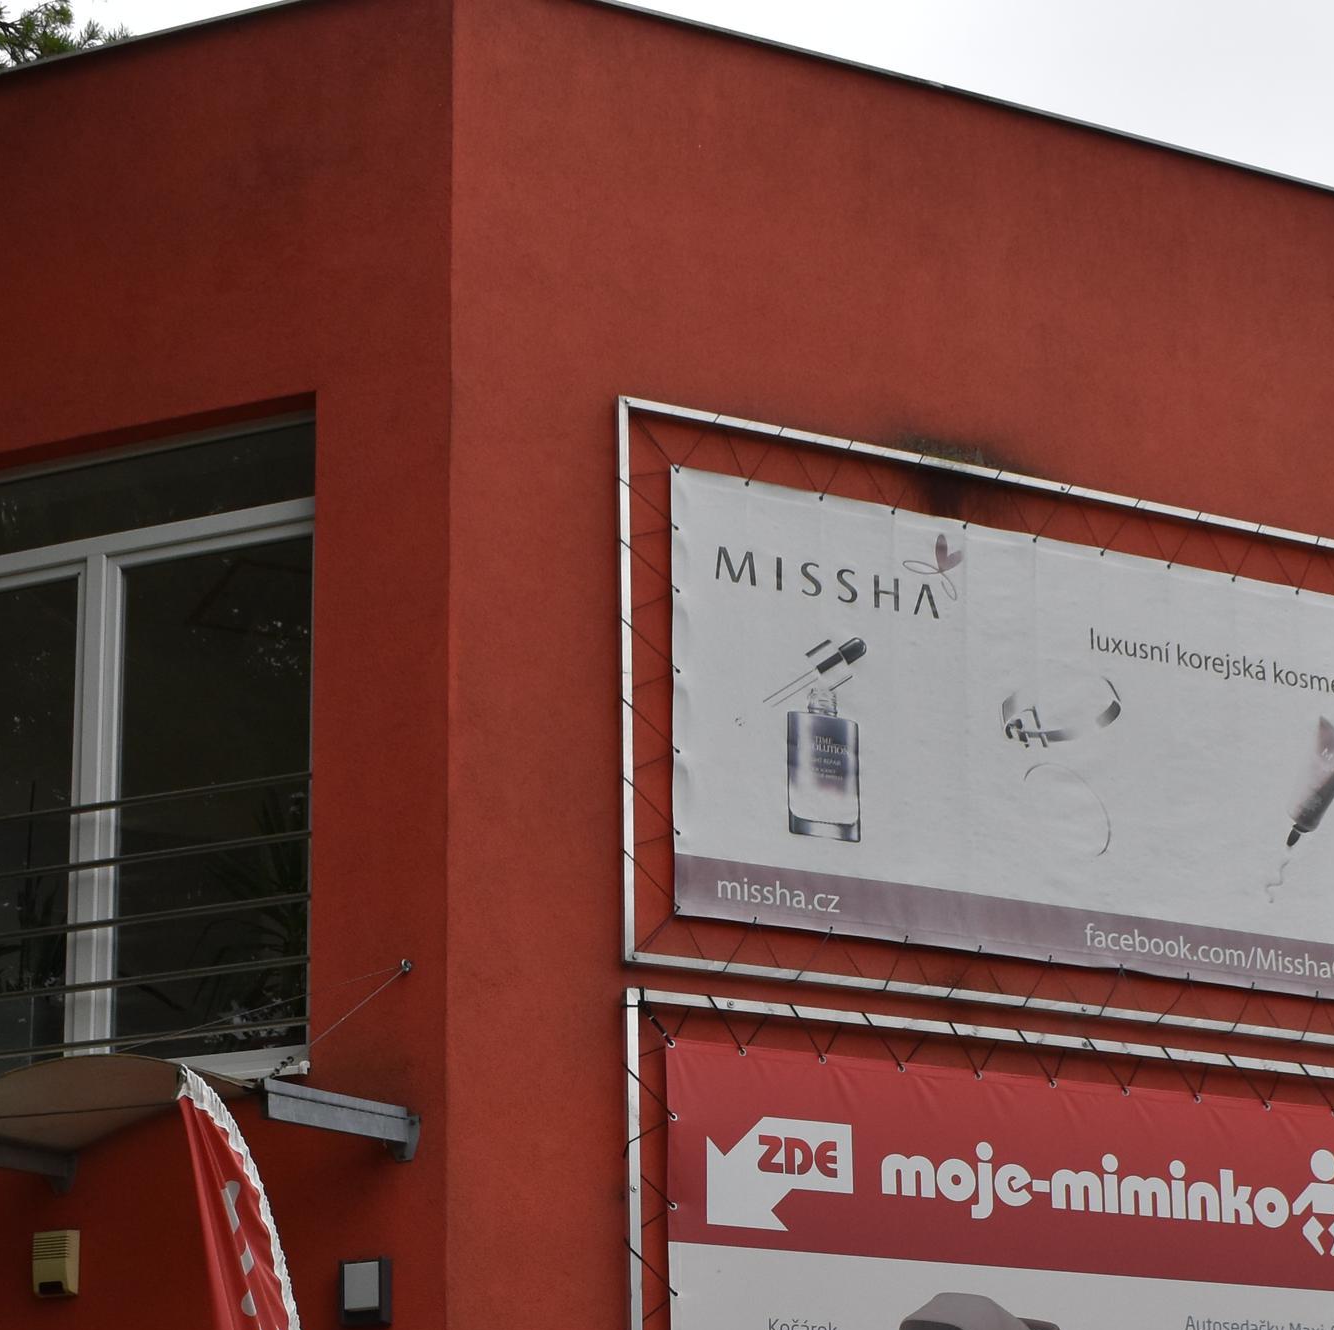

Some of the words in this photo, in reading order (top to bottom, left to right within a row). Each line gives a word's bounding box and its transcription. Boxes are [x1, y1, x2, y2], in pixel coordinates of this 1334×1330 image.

[715, 546, 940, 619] MISSHA
[1090, 627, 1170, 664] luxusní
[1177, 644, 1266, 681] korejská
[717, 878, 841, 913] missha.cz
[757, 1134, 838, 1179] ZDE
